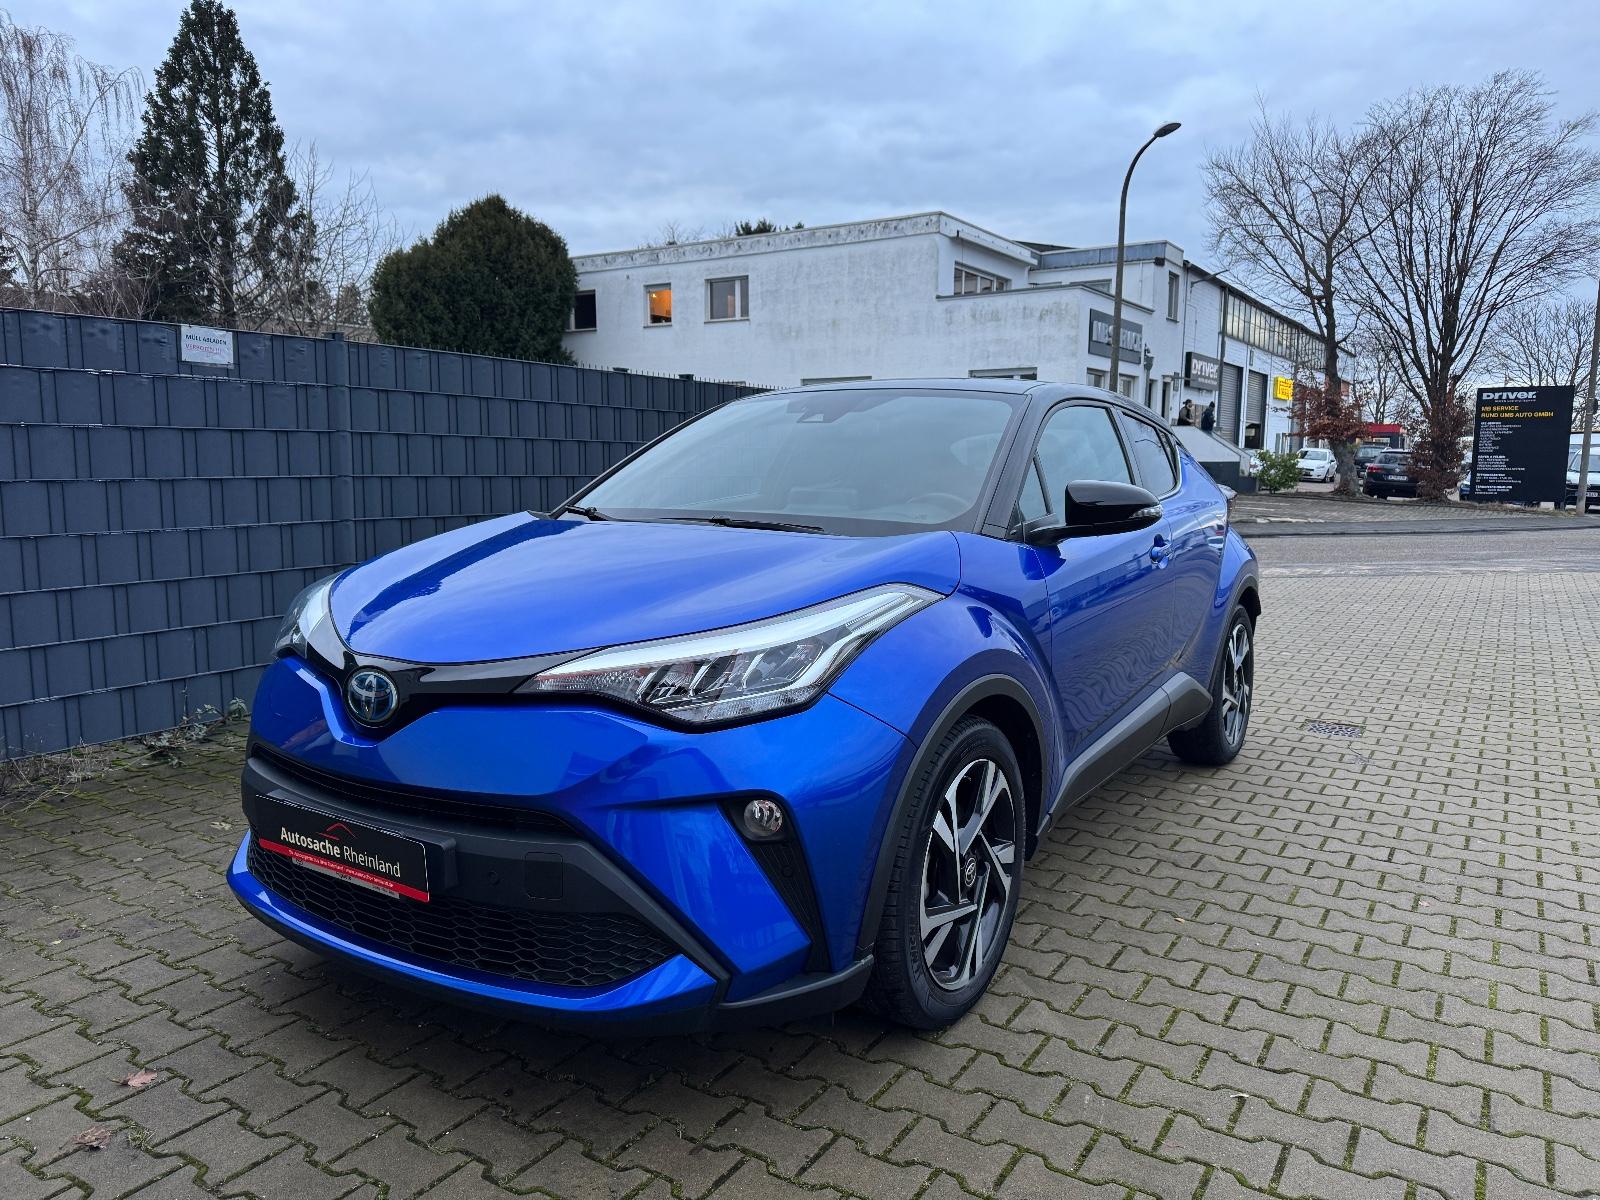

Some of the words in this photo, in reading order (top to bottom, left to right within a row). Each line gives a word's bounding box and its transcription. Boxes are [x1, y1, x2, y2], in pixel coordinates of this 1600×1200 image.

[185, 333, 202, 342] MÜLL
[203, 336, 227, 345] ABLADEN
[280, 826, 341, 858] Autosache
[343, 845, 401, 878] Rheinland
